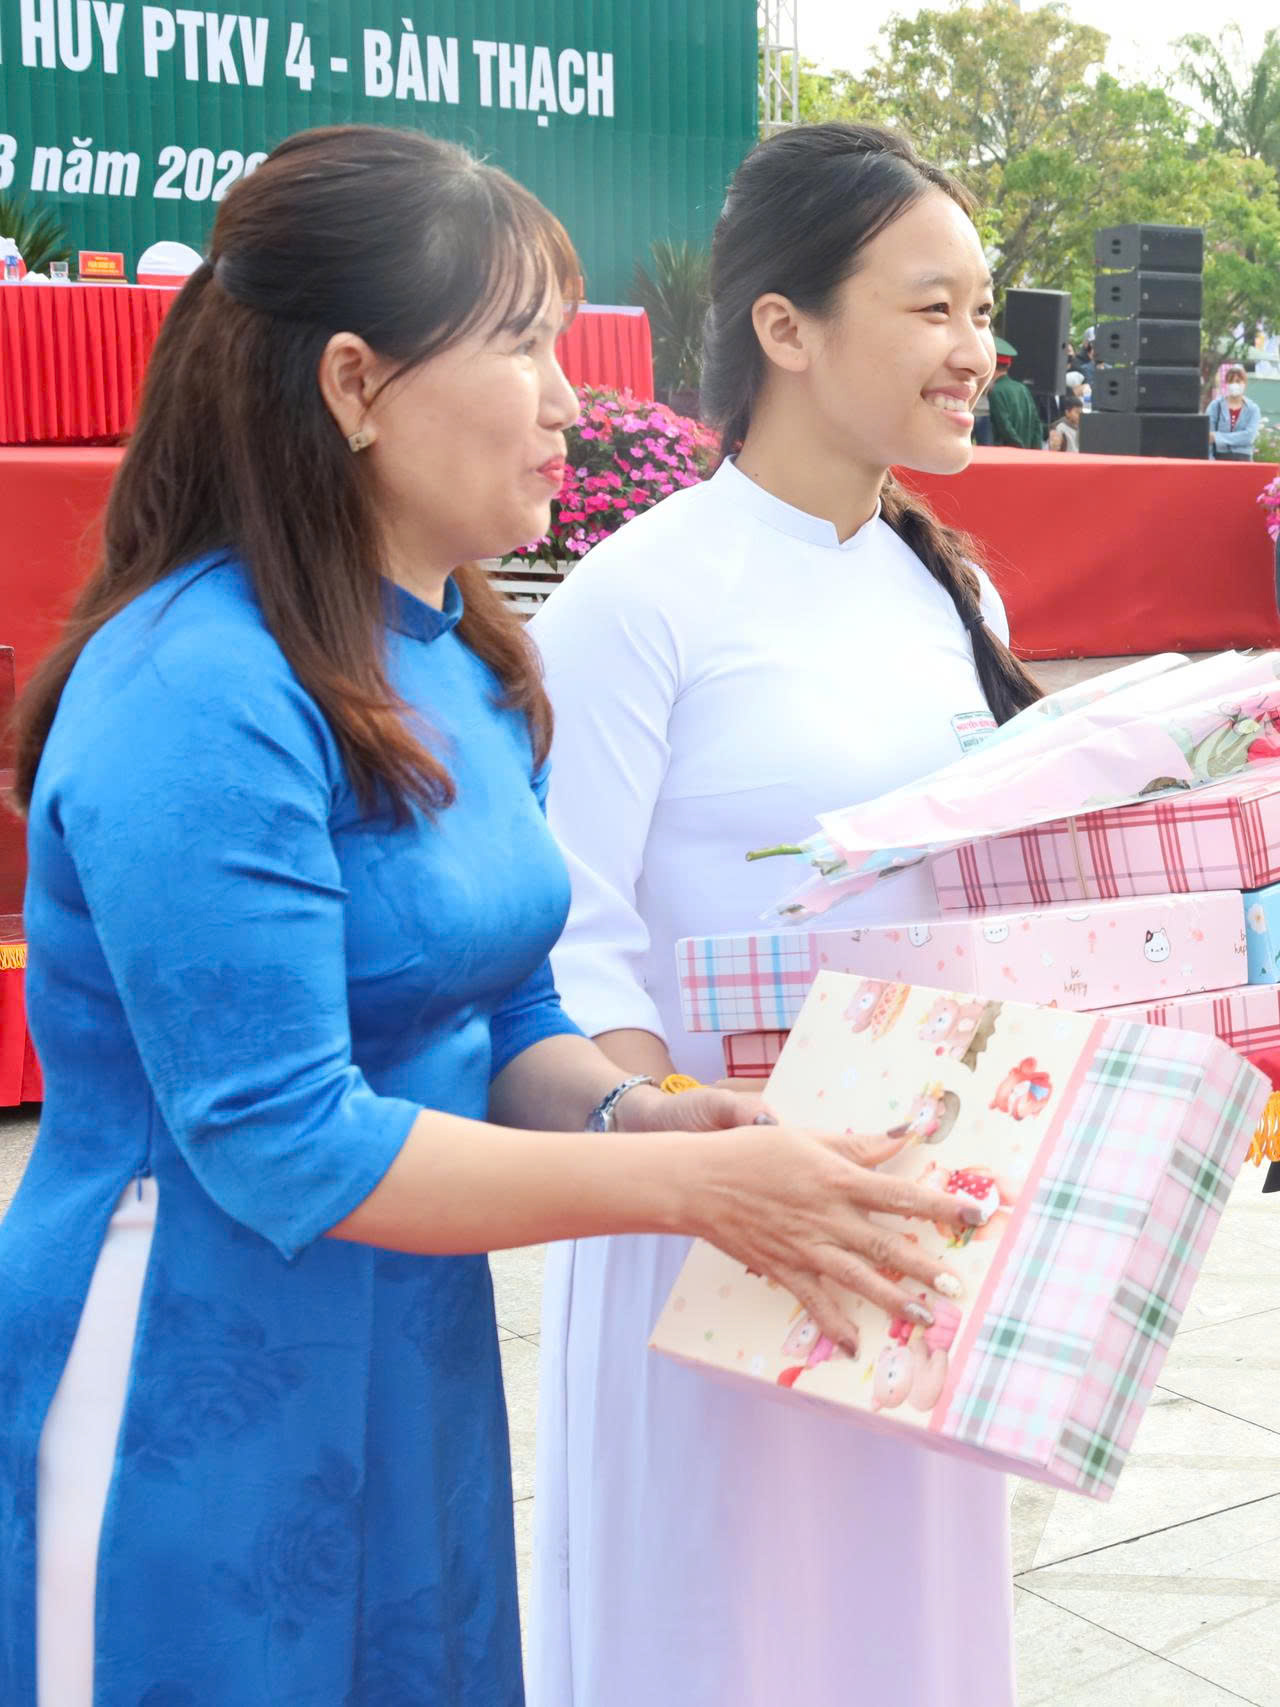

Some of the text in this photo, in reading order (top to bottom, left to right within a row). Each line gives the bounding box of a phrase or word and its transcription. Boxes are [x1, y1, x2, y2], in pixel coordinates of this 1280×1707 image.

[20, 0, 614, 127] HUY PTKV 4 - BÀN THẠCH
[30, 136, 140, 197] năm
